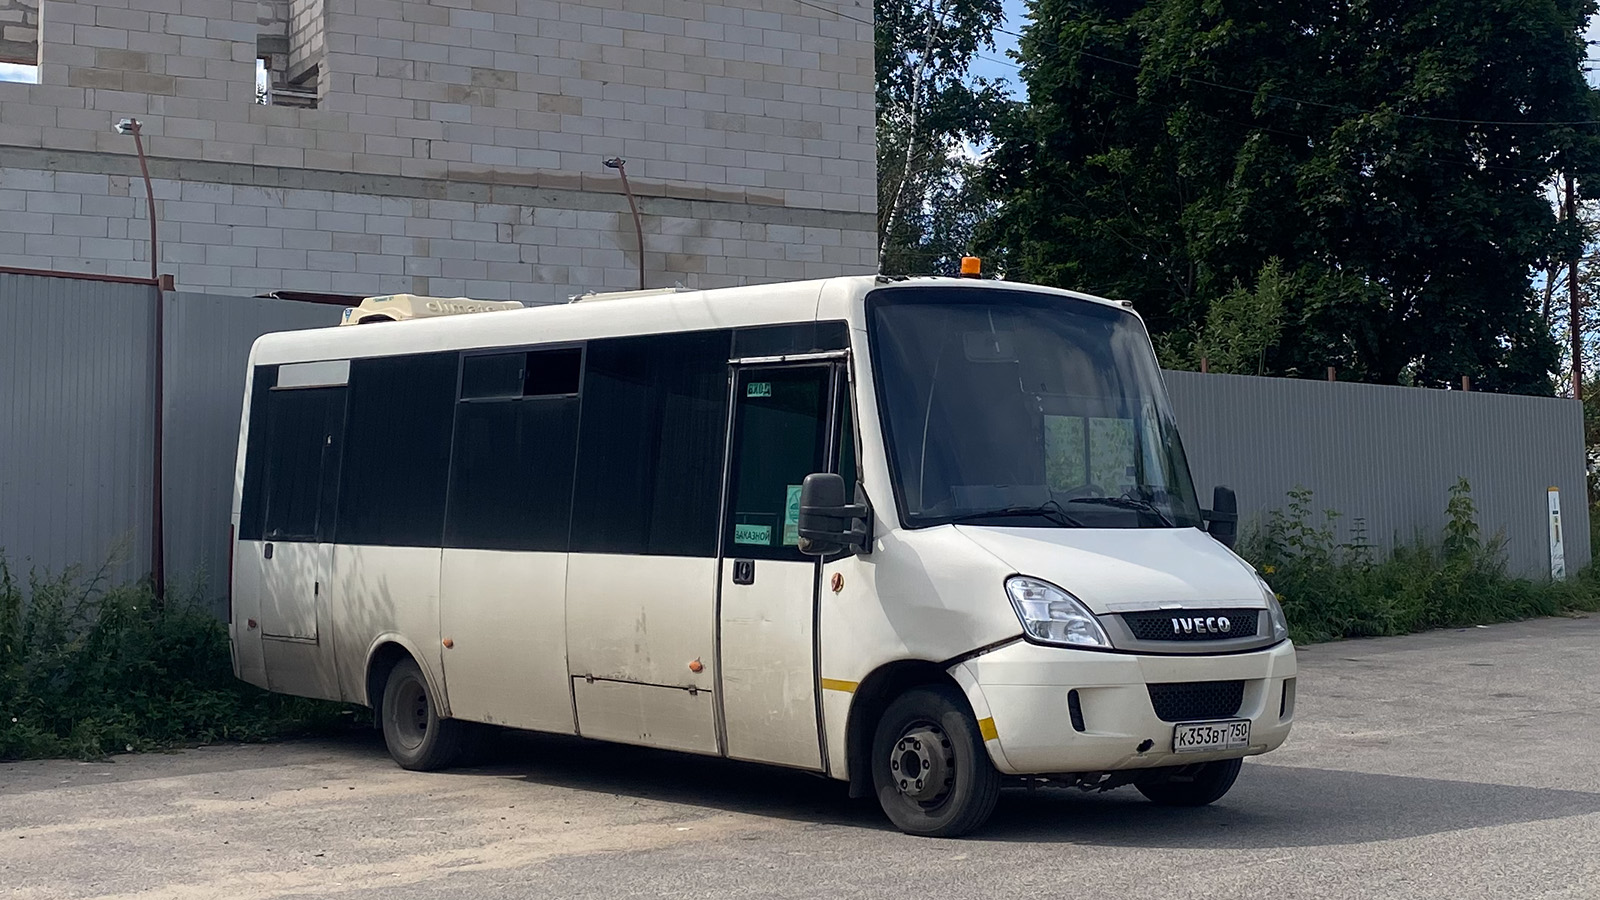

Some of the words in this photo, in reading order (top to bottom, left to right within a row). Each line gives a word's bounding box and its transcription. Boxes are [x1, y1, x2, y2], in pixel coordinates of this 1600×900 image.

[735, 530, 770, 541] ЗАКАЗНОЙ
[1171, 616, 1231, 634] IVECO
[1230, 723, 1247, 737] 750
